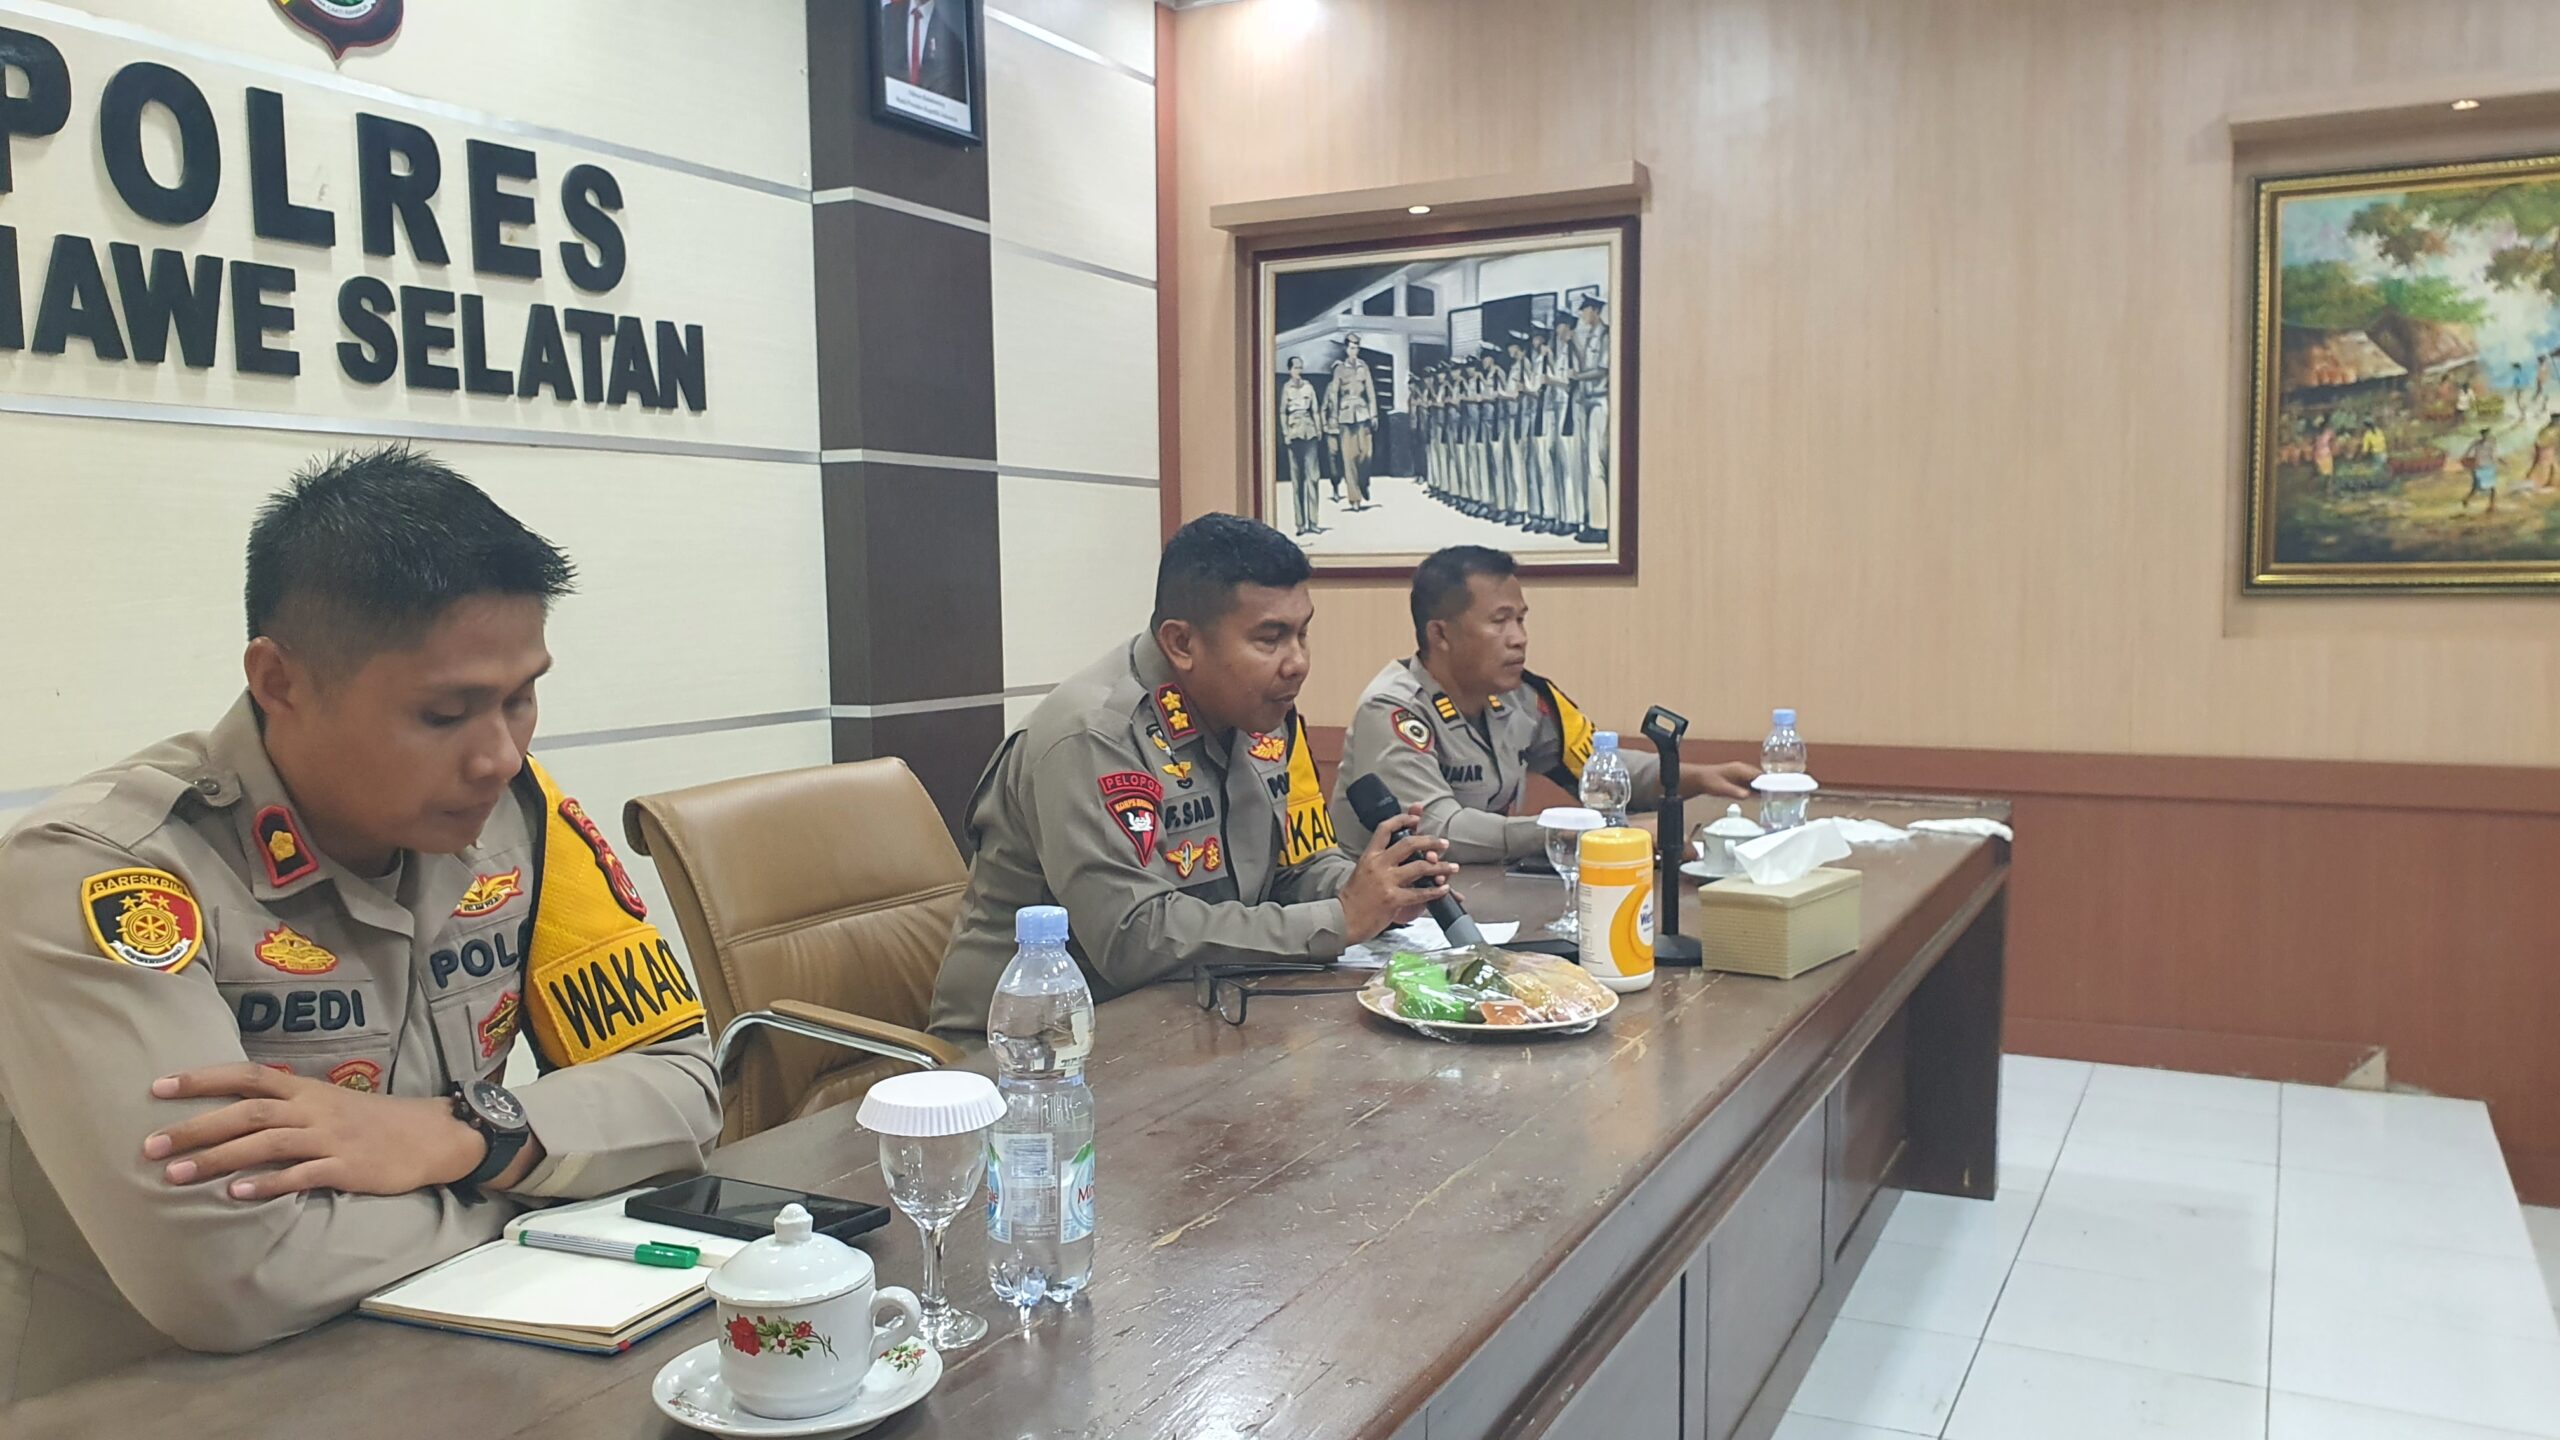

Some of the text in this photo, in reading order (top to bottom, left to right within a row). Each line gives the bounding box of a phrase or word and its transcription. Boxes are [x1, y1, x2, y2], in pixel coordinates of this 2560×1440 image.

[0, 26, 627, 293] POLRES
[336, 276, 707, 412] SELATAN
[430, 920, 526, 988] POL
[549, 938, 699, 1049] WAKAO
[238, 988, 366, 1032] DEDI
